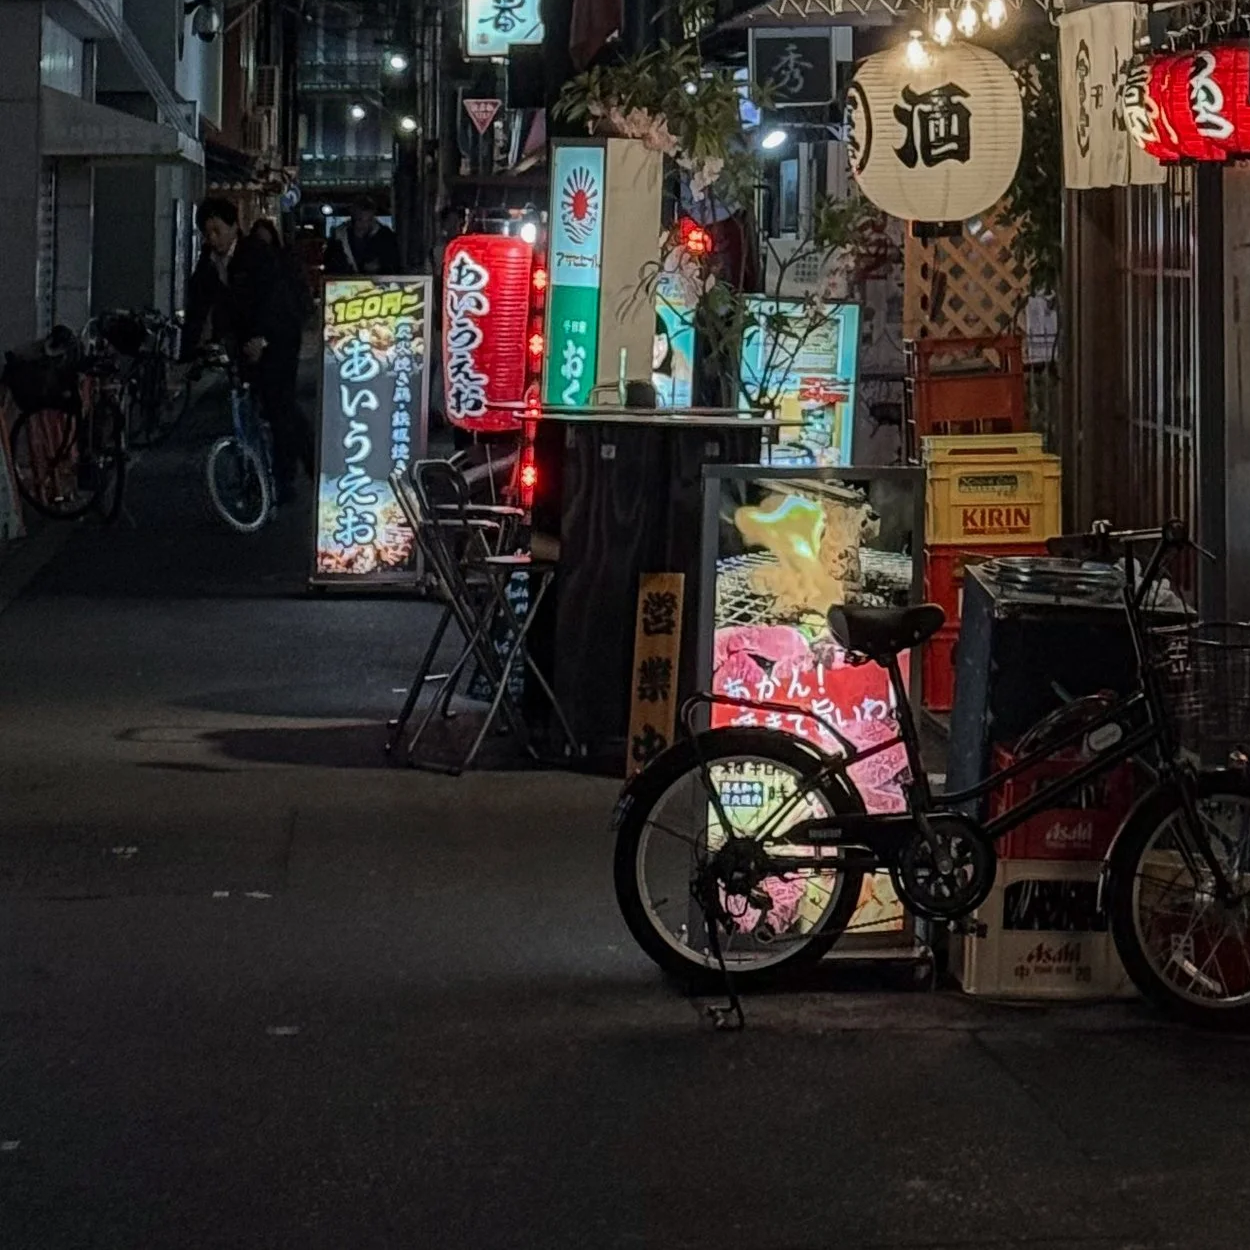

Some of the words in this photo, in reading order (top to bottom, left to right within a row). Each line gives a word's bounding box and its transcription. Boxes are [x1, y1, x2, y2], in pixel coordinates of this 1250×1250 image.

[892, 81, 972, 169] 酒
[333, 338, 382, 547] あいうえお
[961, 508, 1031, 528] KIRIN
[1045, 821, 1093, 841] Asahi
[1027, 942, 1081, 963] Asahi
